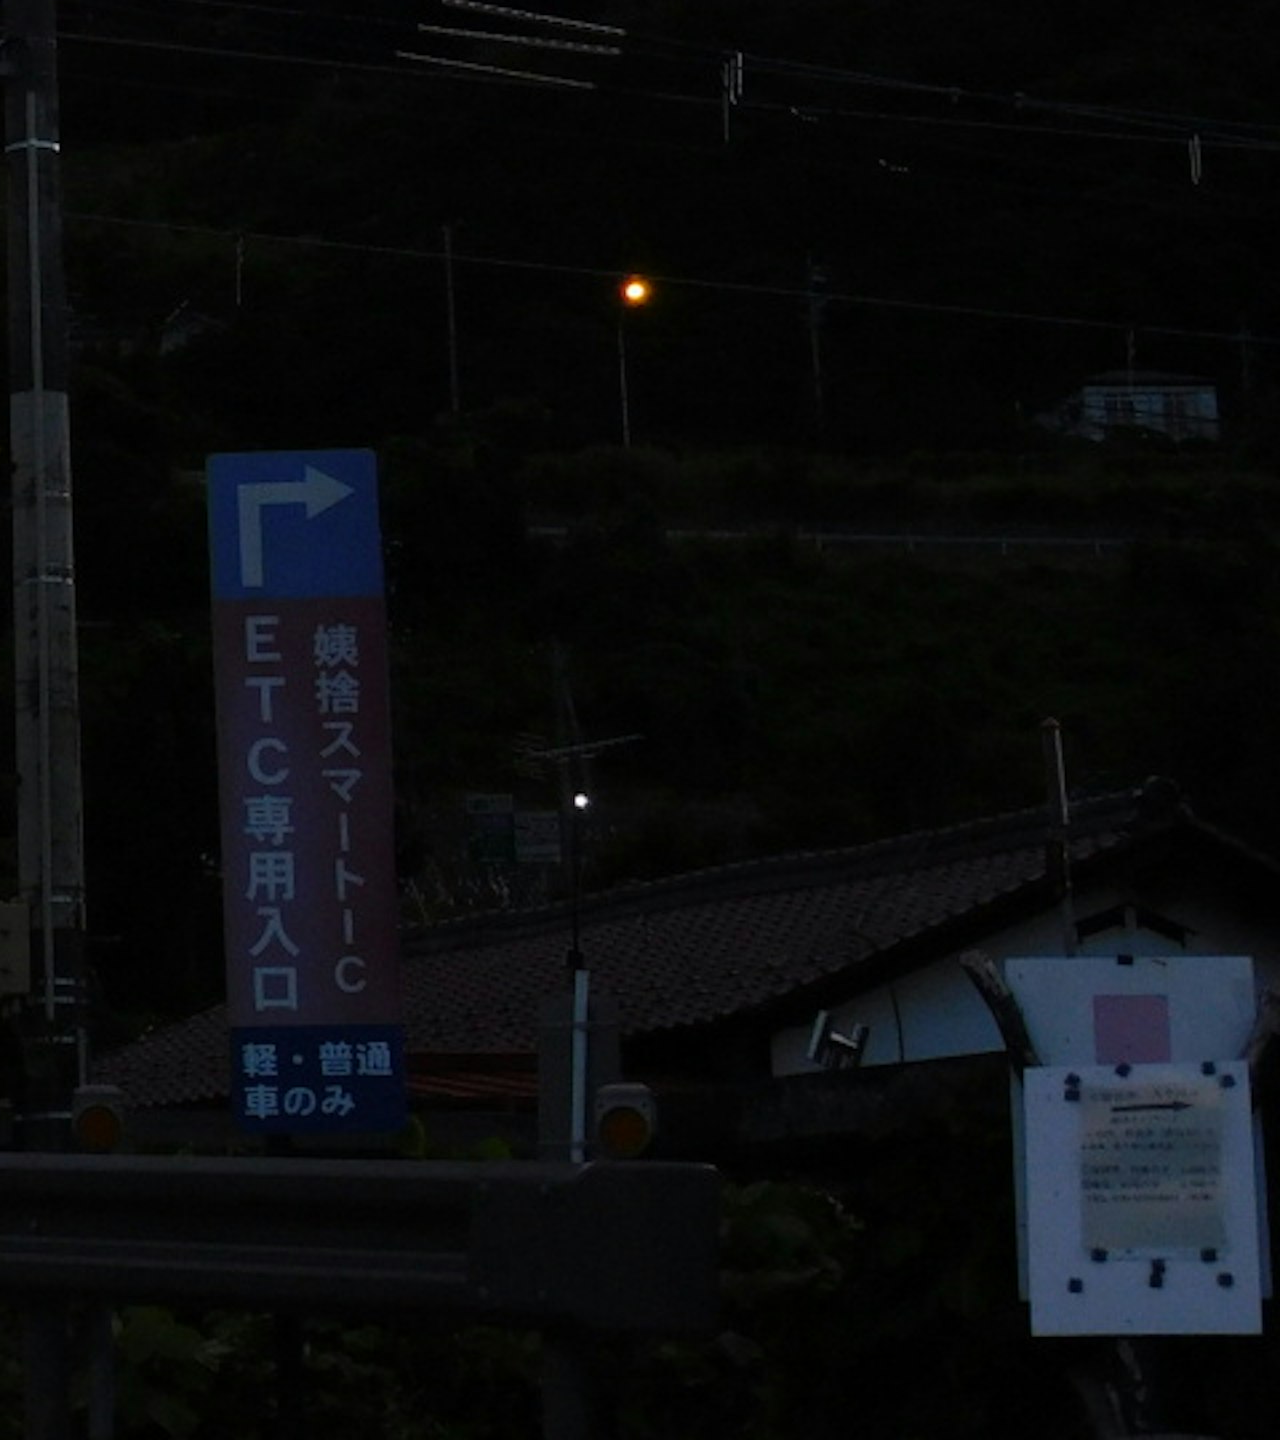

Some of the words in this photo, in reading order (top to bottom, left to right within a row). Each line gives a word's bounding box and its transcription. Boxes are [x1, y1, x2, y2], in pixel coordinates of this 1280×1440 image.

[243, 614, 300, 1011] ETC専用入口
[243, 1084, 356, 1120] 車のみ
